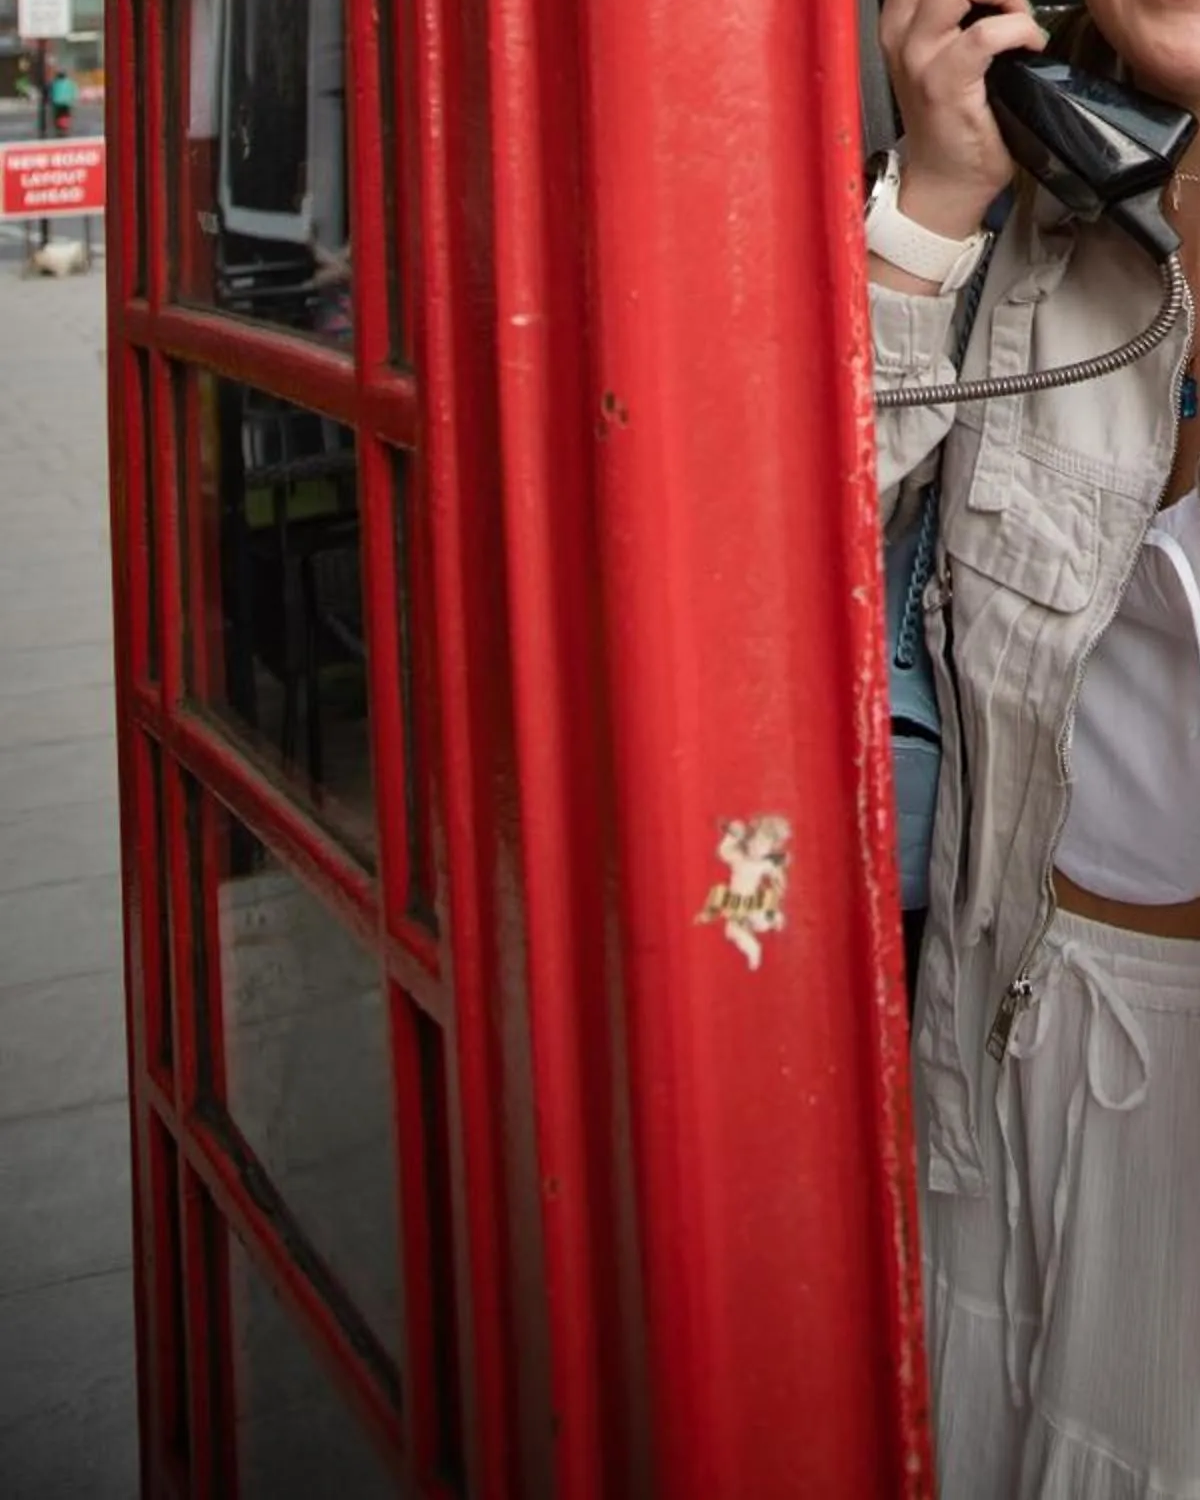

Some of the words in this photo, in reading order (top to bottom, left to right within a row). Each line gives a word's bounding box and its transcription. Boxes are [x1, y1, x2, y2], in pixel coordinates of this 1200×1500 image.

[8, 154, 48, 171] NEW
[51, 149, 100, 168] ROAD
[20, 168, 87, 189] LAYOUT
[23, 185, 85, 206] AHEAD
